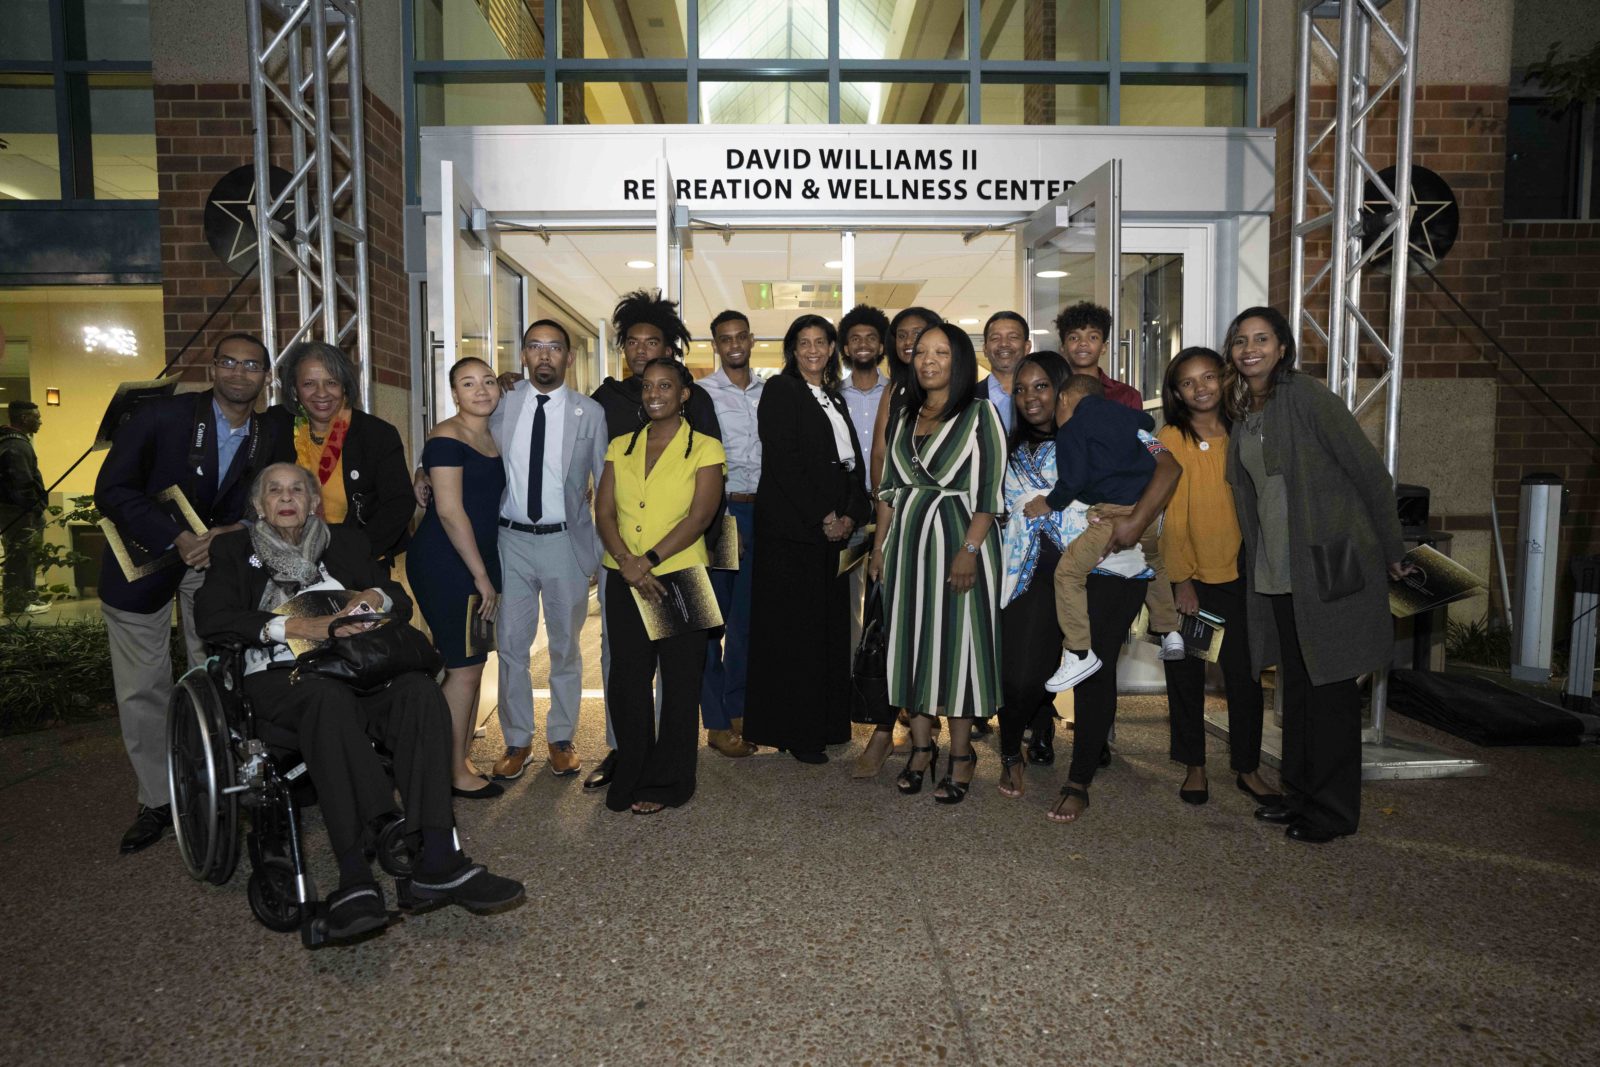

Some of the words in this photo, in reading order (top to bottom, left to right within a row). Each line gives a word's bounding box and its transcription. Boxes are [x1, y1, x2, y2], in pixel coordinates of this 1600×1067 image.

[726, 148, 812, 170] DAVID
[818, 148, 953, 170] WILLIAMS
[962, 149, 977, 171] II
[623, 178, 792, 200] REREATION
[801, 178, 820, 200] &
[827, 178, 968, 200] WELLNESS
[195, 422, 206, 448] Canon
